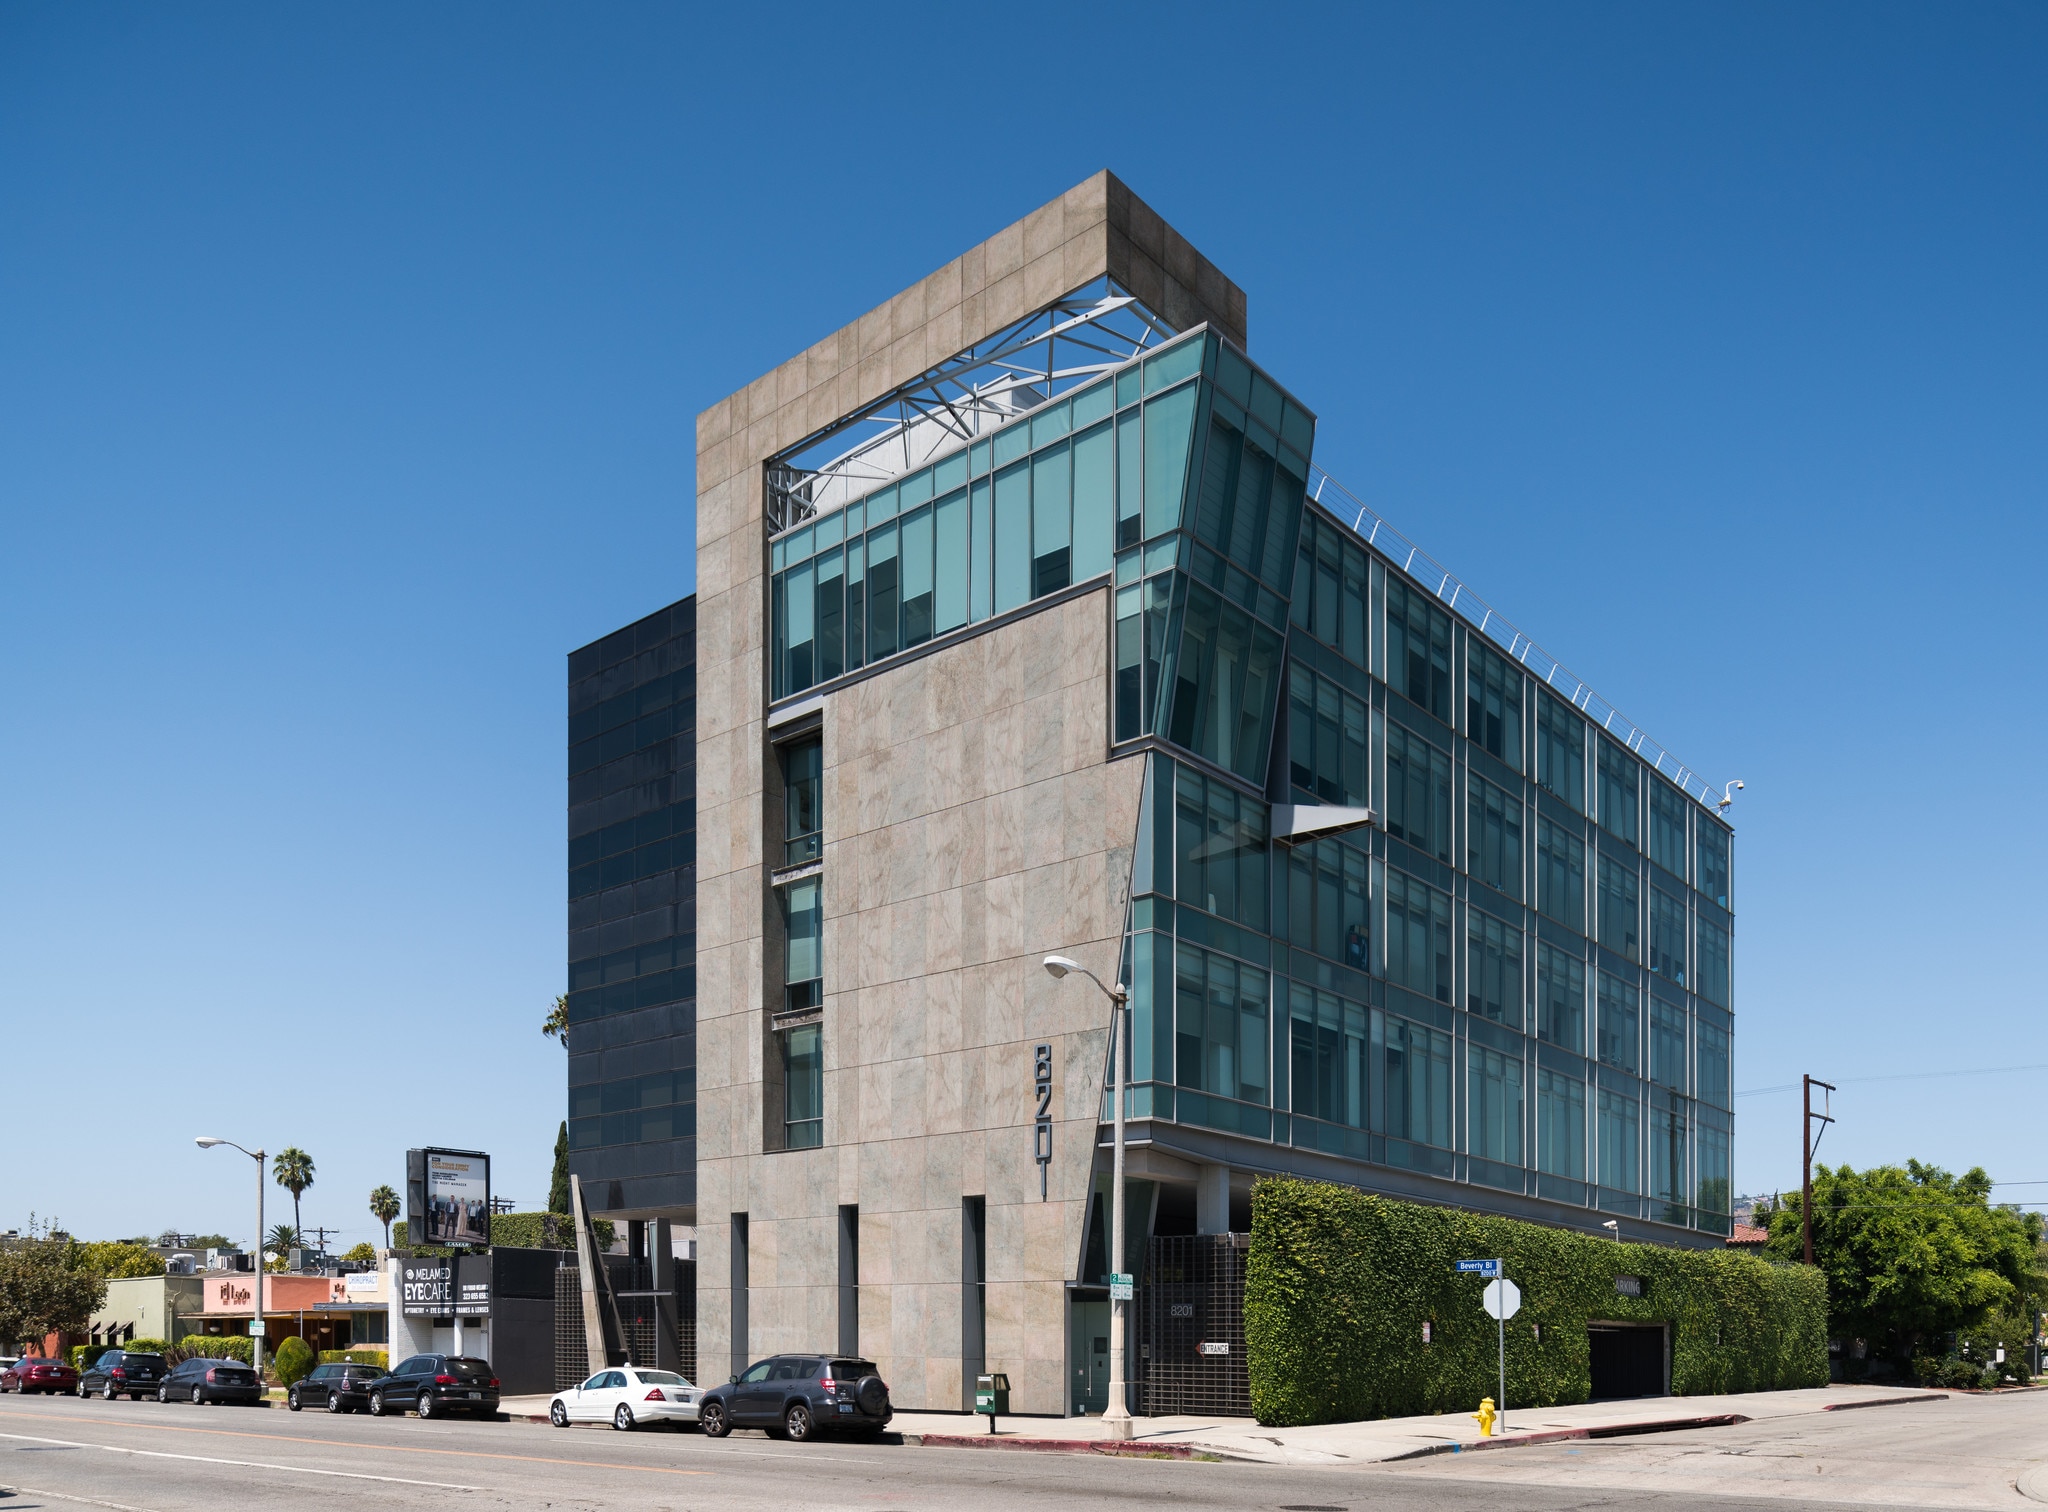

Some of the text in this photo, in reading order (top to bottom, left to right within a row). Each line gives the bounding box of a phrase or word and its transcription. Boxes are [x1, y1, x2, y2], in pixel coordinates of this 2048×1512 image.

[1034, 1043, 1052, 1196] 8201
[1461, 1262, 1483, 1270] Beverly
[416, 1268, 450, 1280] MELAMED
[404, 1282, 452, 1301] EYECARE
[1615, 1279, 1641, 1294] ARKING
[1170, 1305, 1193, 1316] 8201
[1200, 1344, 1228, 1353] ENTRANCE
